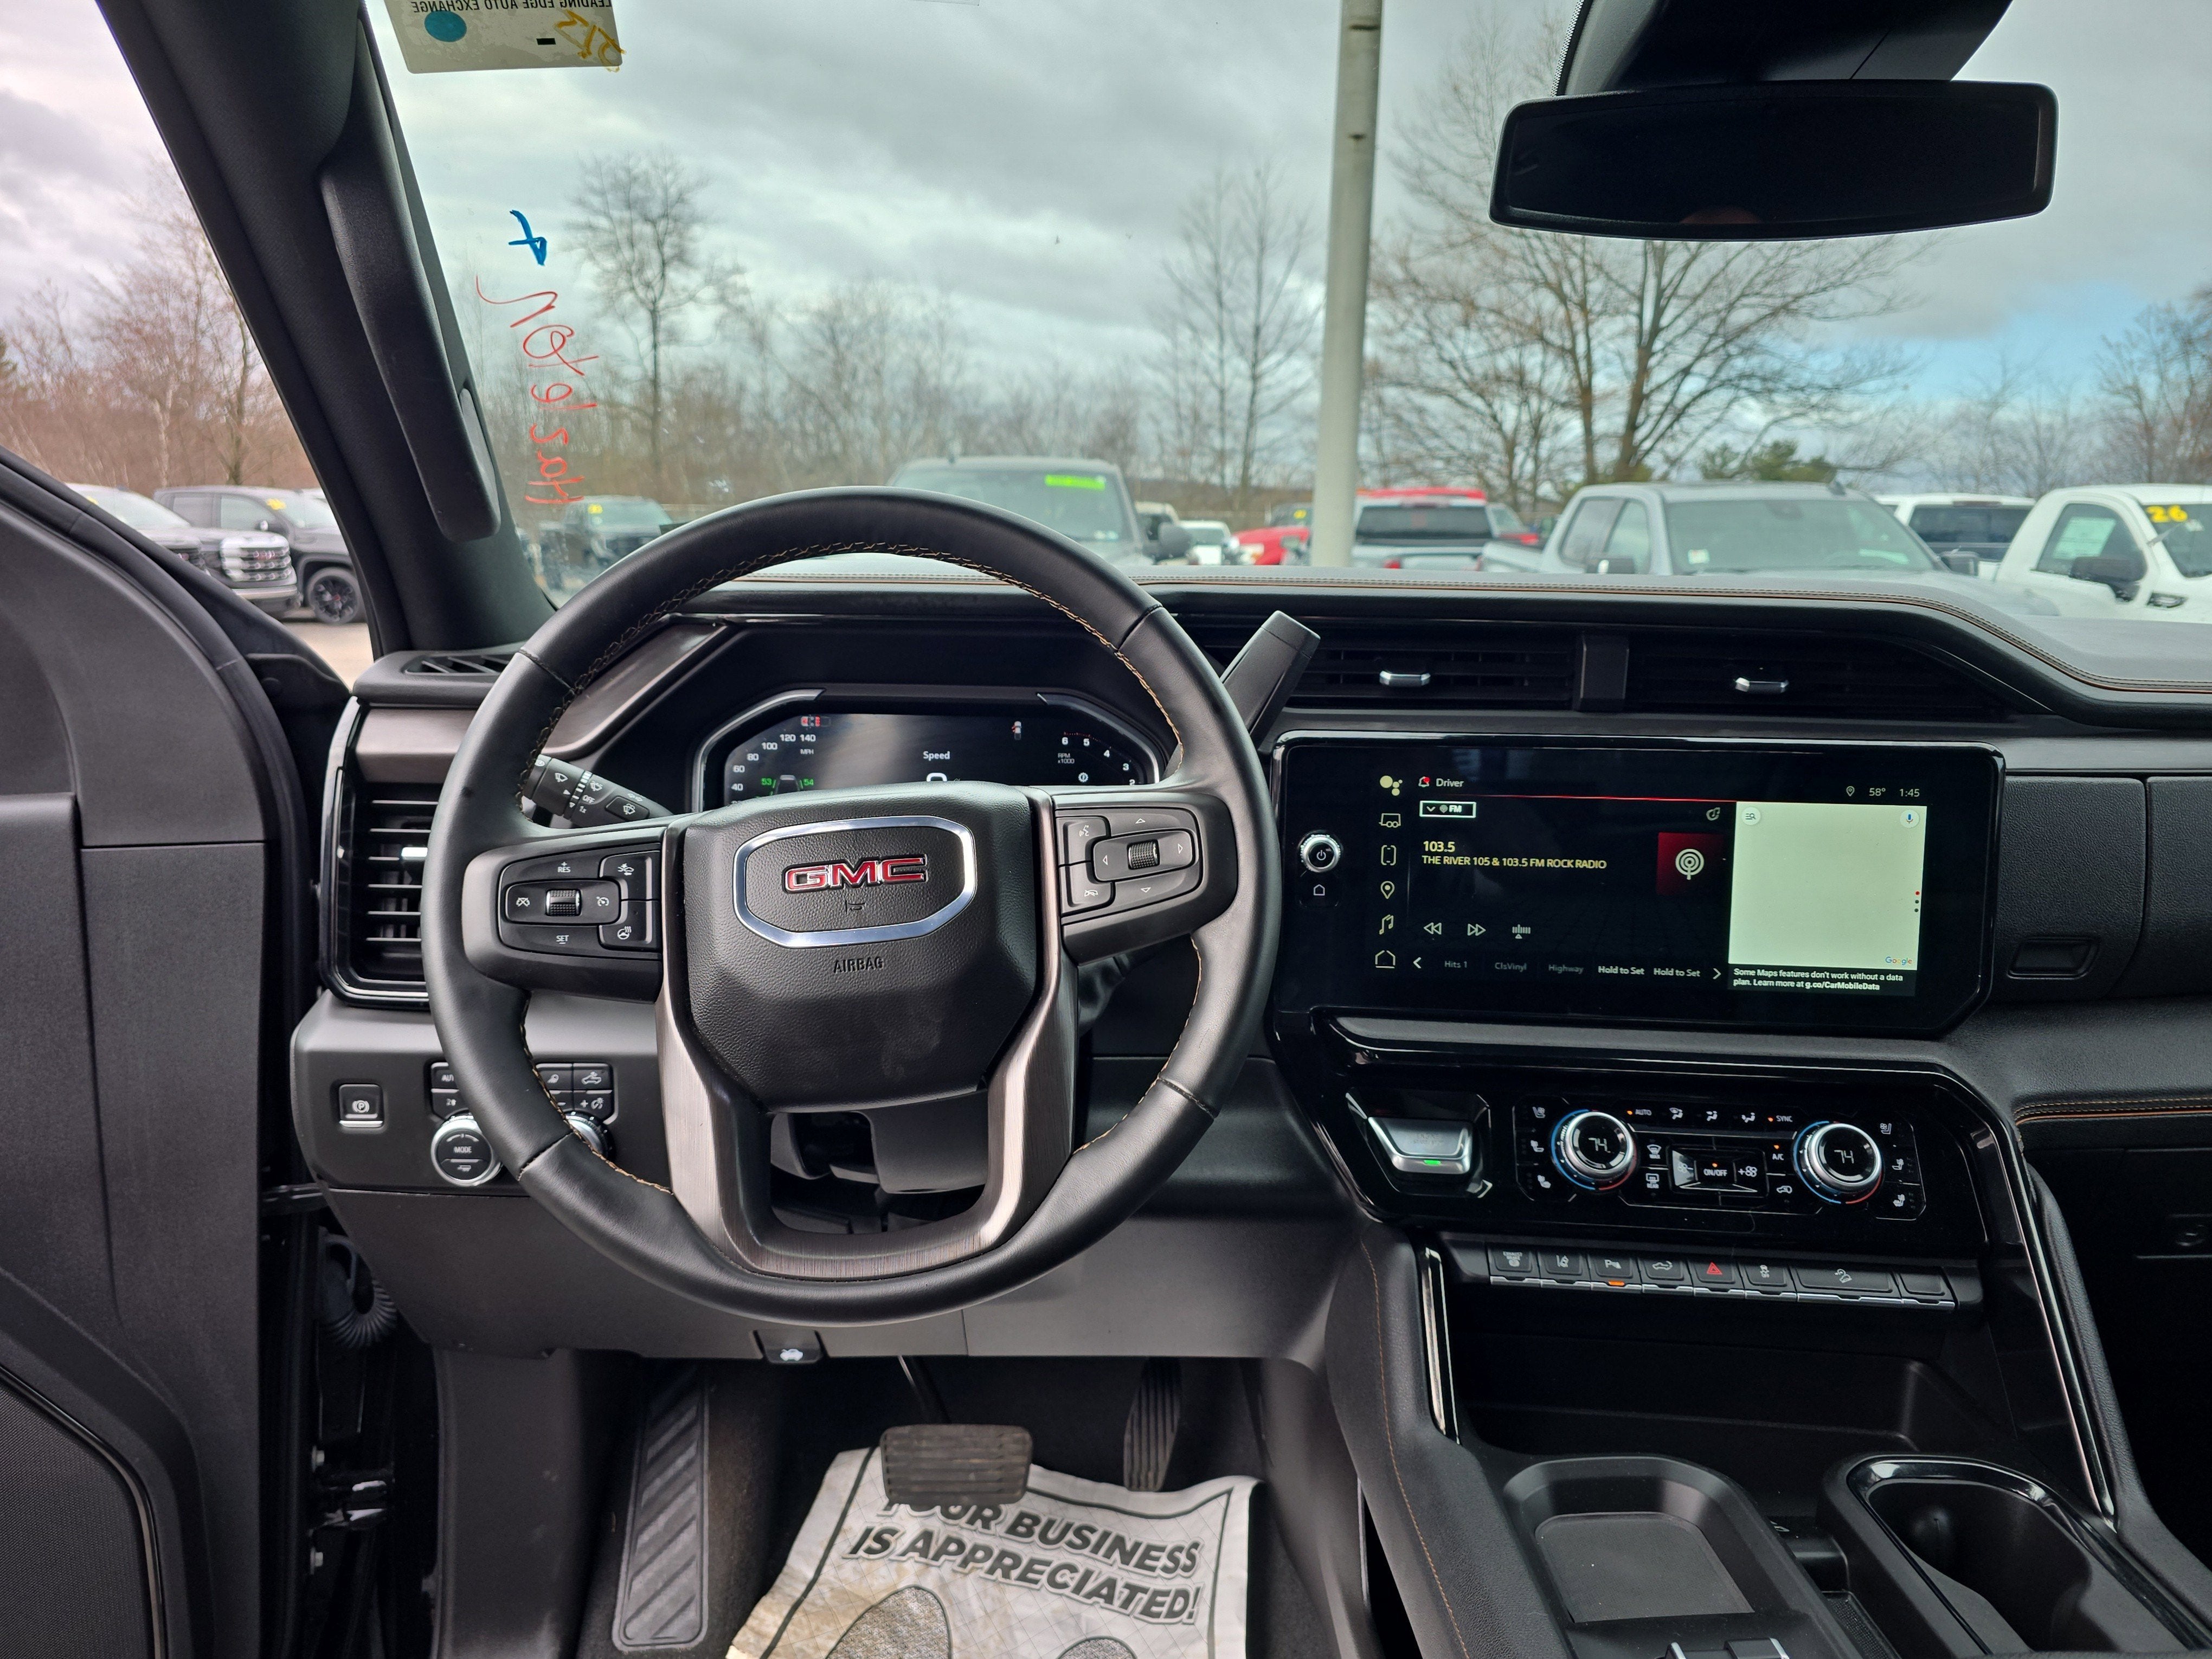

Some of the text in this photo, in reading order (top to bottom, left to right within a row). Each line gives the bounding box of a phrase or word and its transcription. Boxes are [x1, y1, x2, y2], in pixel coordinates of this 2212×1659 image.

[2146, 505, 2188, 523] 26
[1083, 738, 1090, 747] 5
[923, 751, 950, 761] Speed
[1103, 749, 1110, 757] 4
[1122, 763, 1129, 771] 3
[1436, 779, 1464, 787] Driver
[1900, 788, 1920, 797] 1:45
[582, 794, 595, 803] OFF
[1423, 841, 1455, 852] 103.5
[1422, 856, 1607, 869] THE RIVER 105 & 103.5 FM ROCK RADIO
[785, 854, 927, 893] GMC
[833, 956, 884, 973] AIRBAG
[1885, 956, 1912, 966] Google
[1495, 962, 1527, 972] ClsVinyl
[1548, 964, 1584, 974] Highway
[1598, 966, 1618, 974] Hold
[1630, 967, 1645, 975] Set
[1686, 969, 1700, 977] Set
[1733, 968, 1756, 976] Some
[1757, 969, 1778, 978] Maps
[1779, 969, 1810, 978] features
[1733, 978, 1752, 986] plan.
[1805, 981, 1880, 990] g.co/CarMobileData
[1588, 1137, 1608, 1151] 74
[1834, 1150, 1854, 1163] 74
[1703, 1168, 1728, 1177] ON/OFF
[884, 1503, 1201, 1574] UR BUSINESS
[848, 1525, 1202, 1620] IS APPRECIATED!
